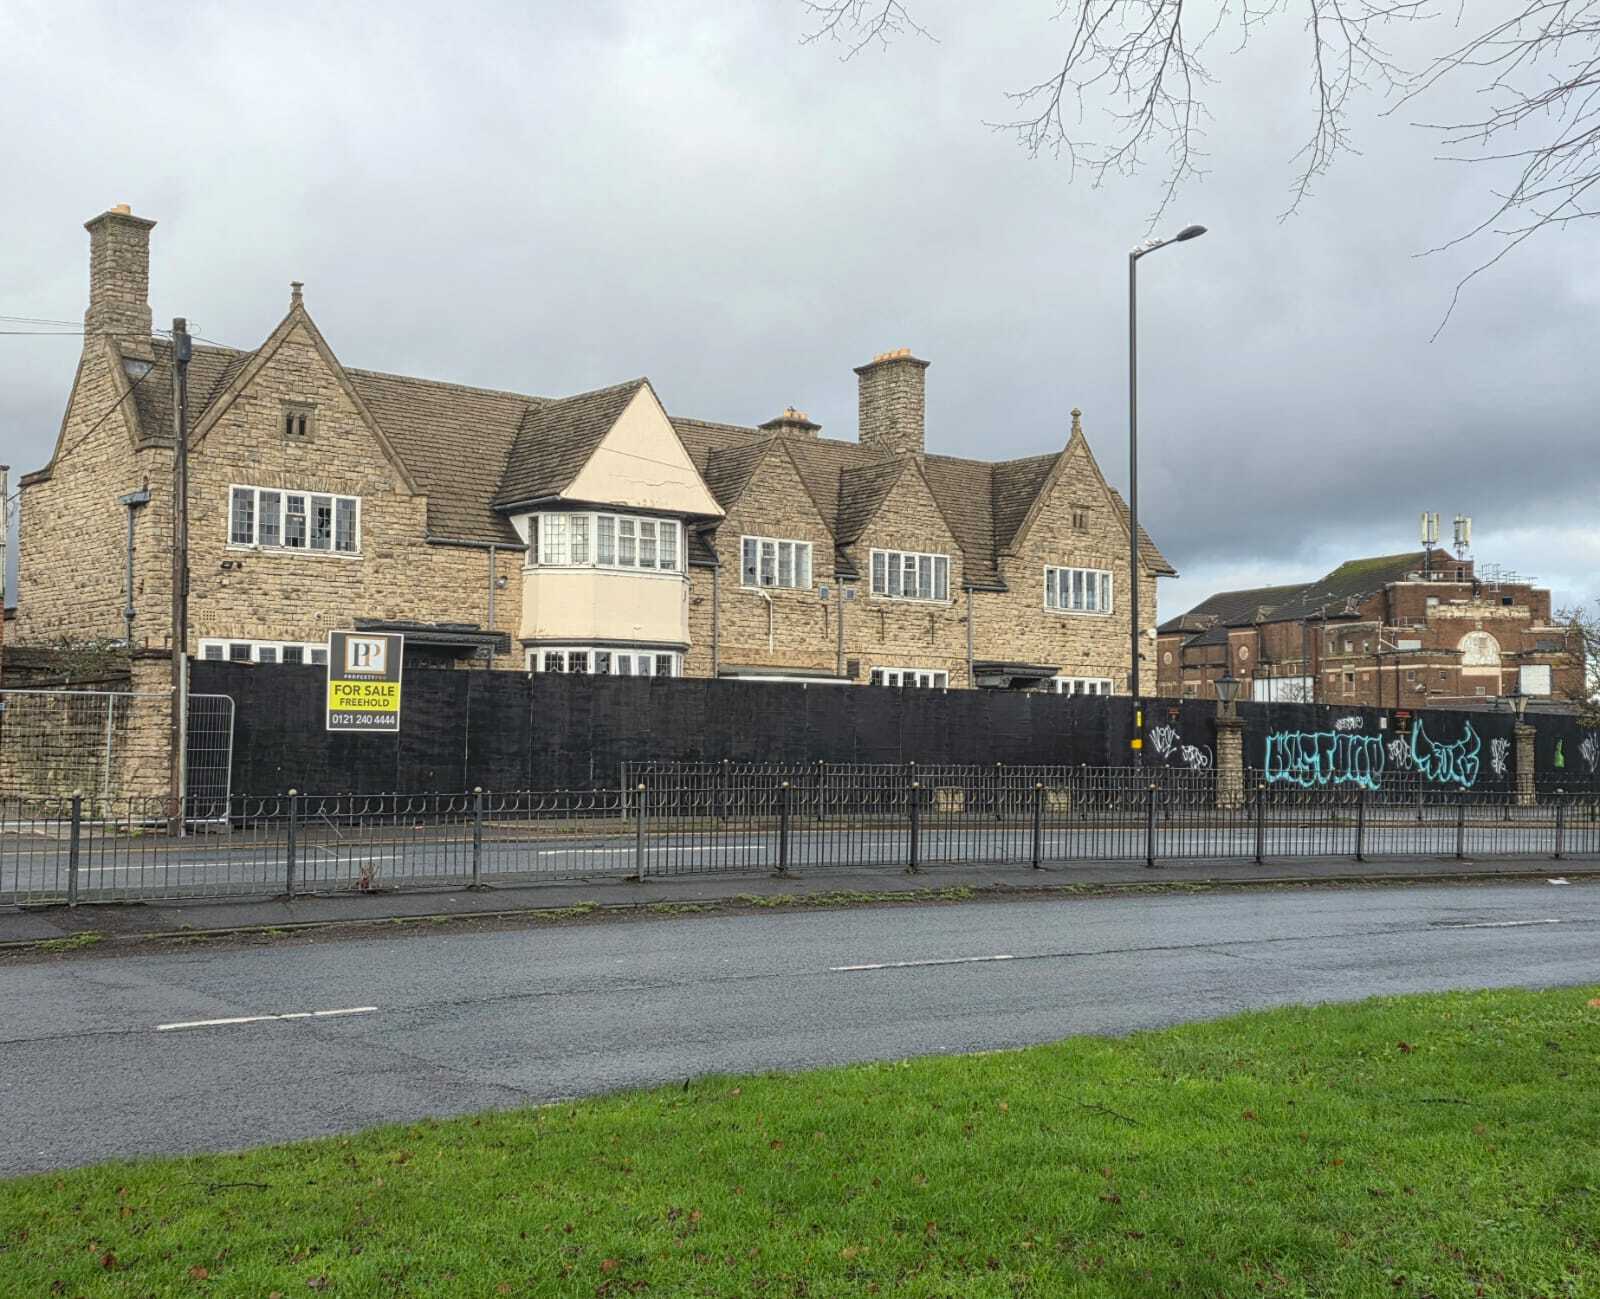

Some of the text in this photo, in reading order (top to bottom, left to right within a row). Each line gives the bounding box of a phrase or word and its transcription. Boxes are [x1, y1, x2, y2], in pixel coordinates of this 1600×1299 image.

[334, 684, 395, 697] FOR SALE
[339, 697, 390, 707] FREEHOLD
[332, 714, 395, 725] 0121 240 4444
